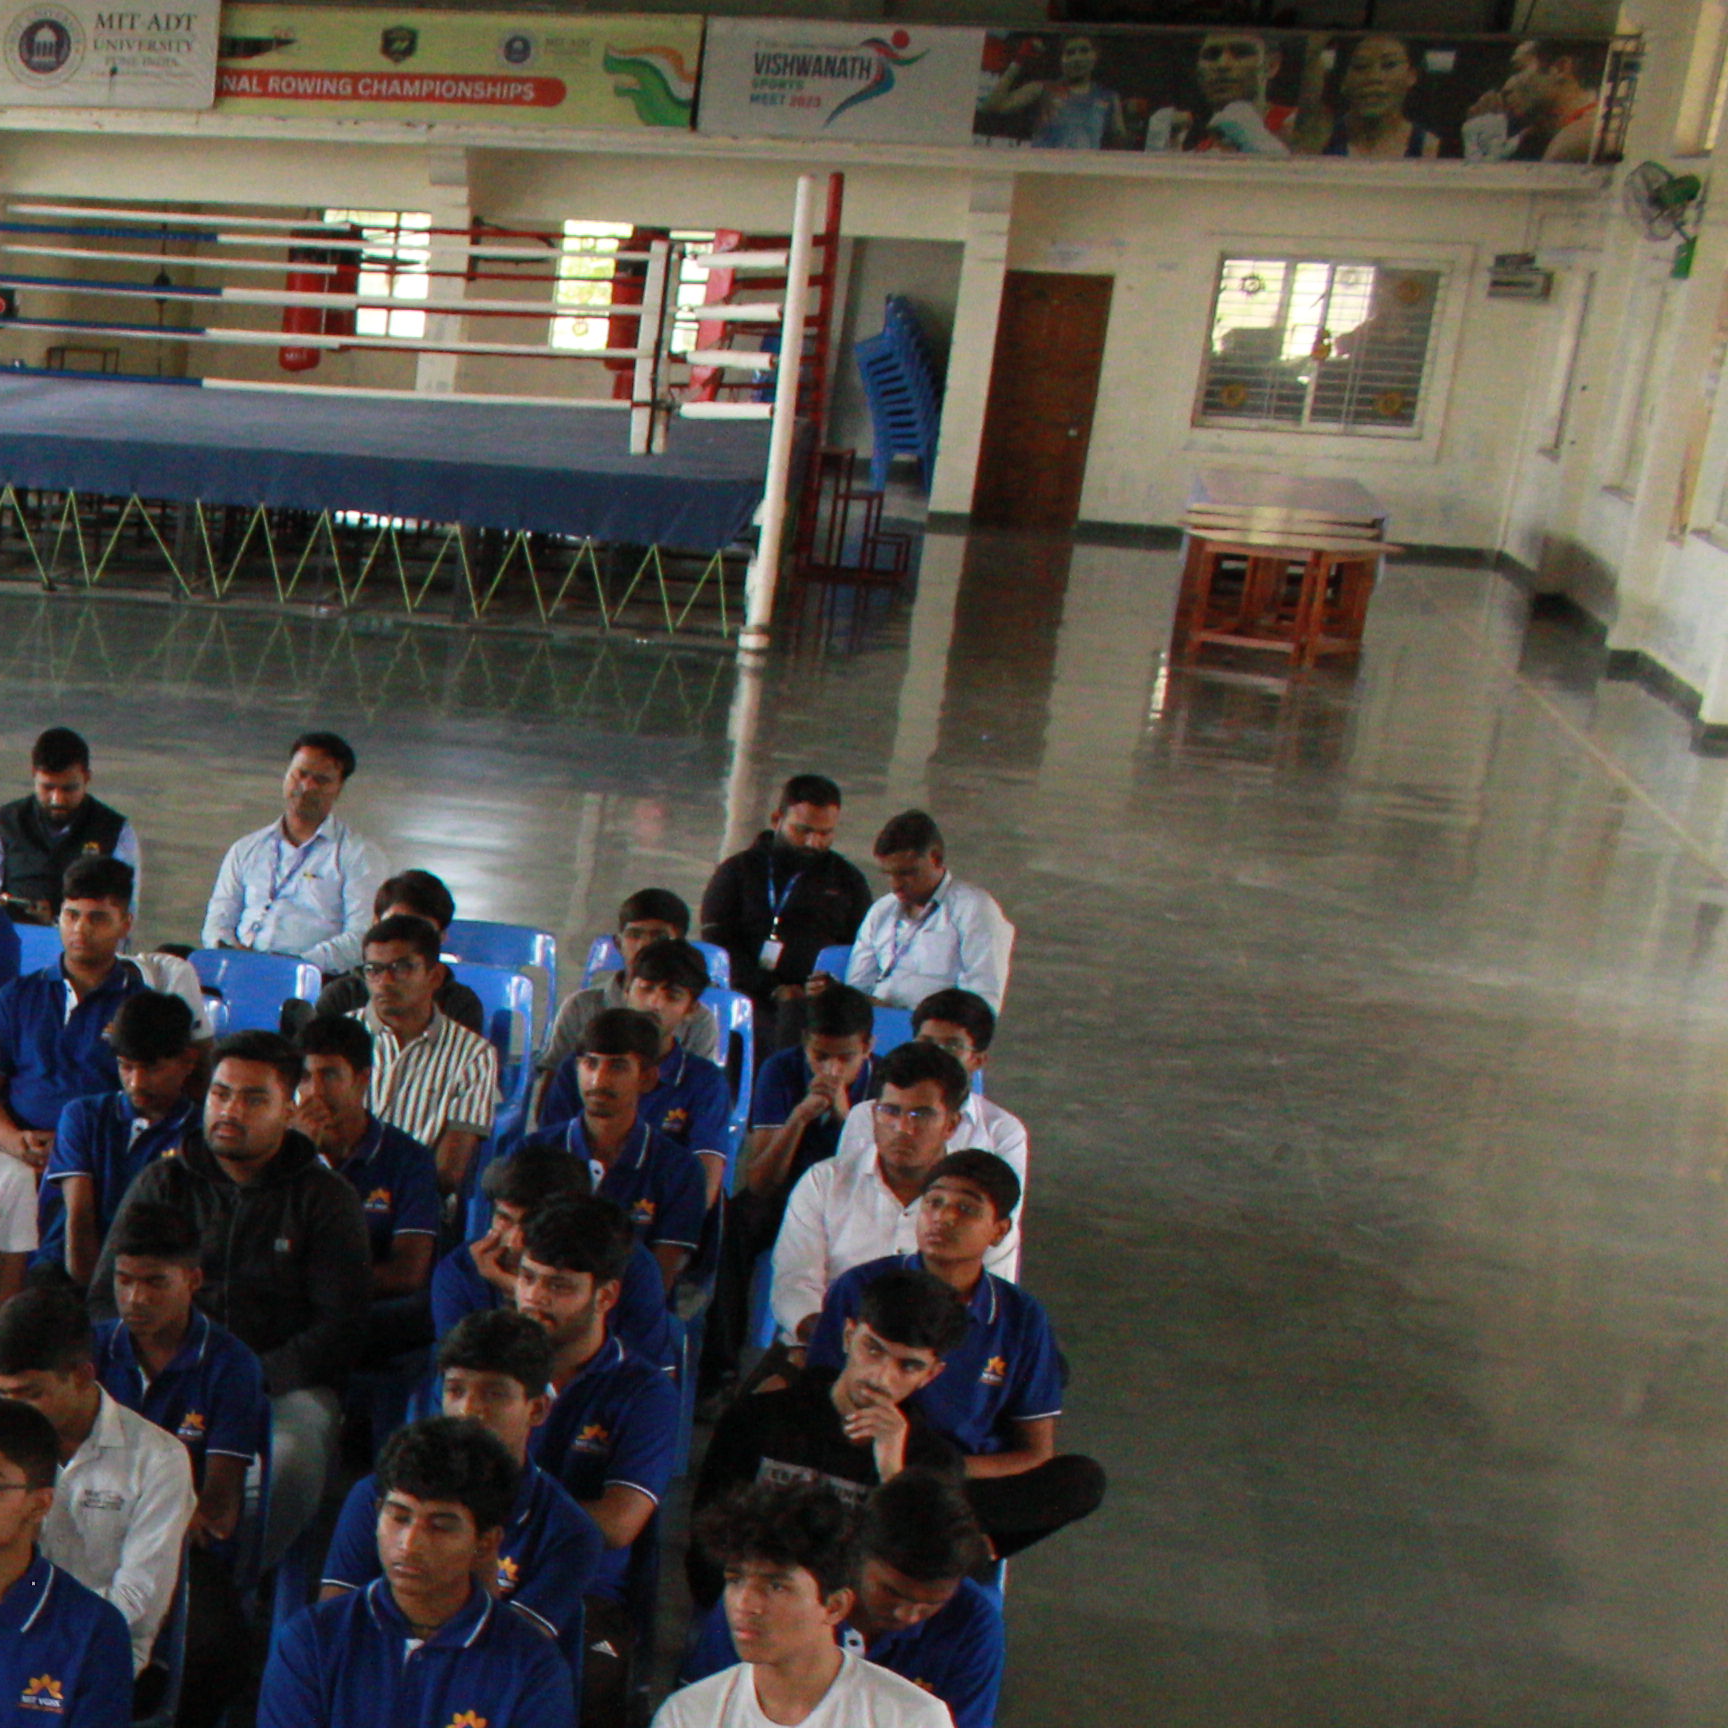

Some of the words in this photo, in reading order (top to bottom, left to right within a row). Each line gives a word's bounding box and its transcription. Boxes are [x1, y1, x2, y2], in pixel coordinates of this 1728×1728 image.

[147, 12, 198, 31] ADT
[93, 38, 194, 53] UNIVERSITY
[754, 52, 872, 80] VISHWANATH
[267, 77, 352, 97] ROWING
[358, 79, 536, 101] CHAMPIONSHIPS
[752, 79, 805, 91] SPORTS
[750, 92, 786, 106] MEET
